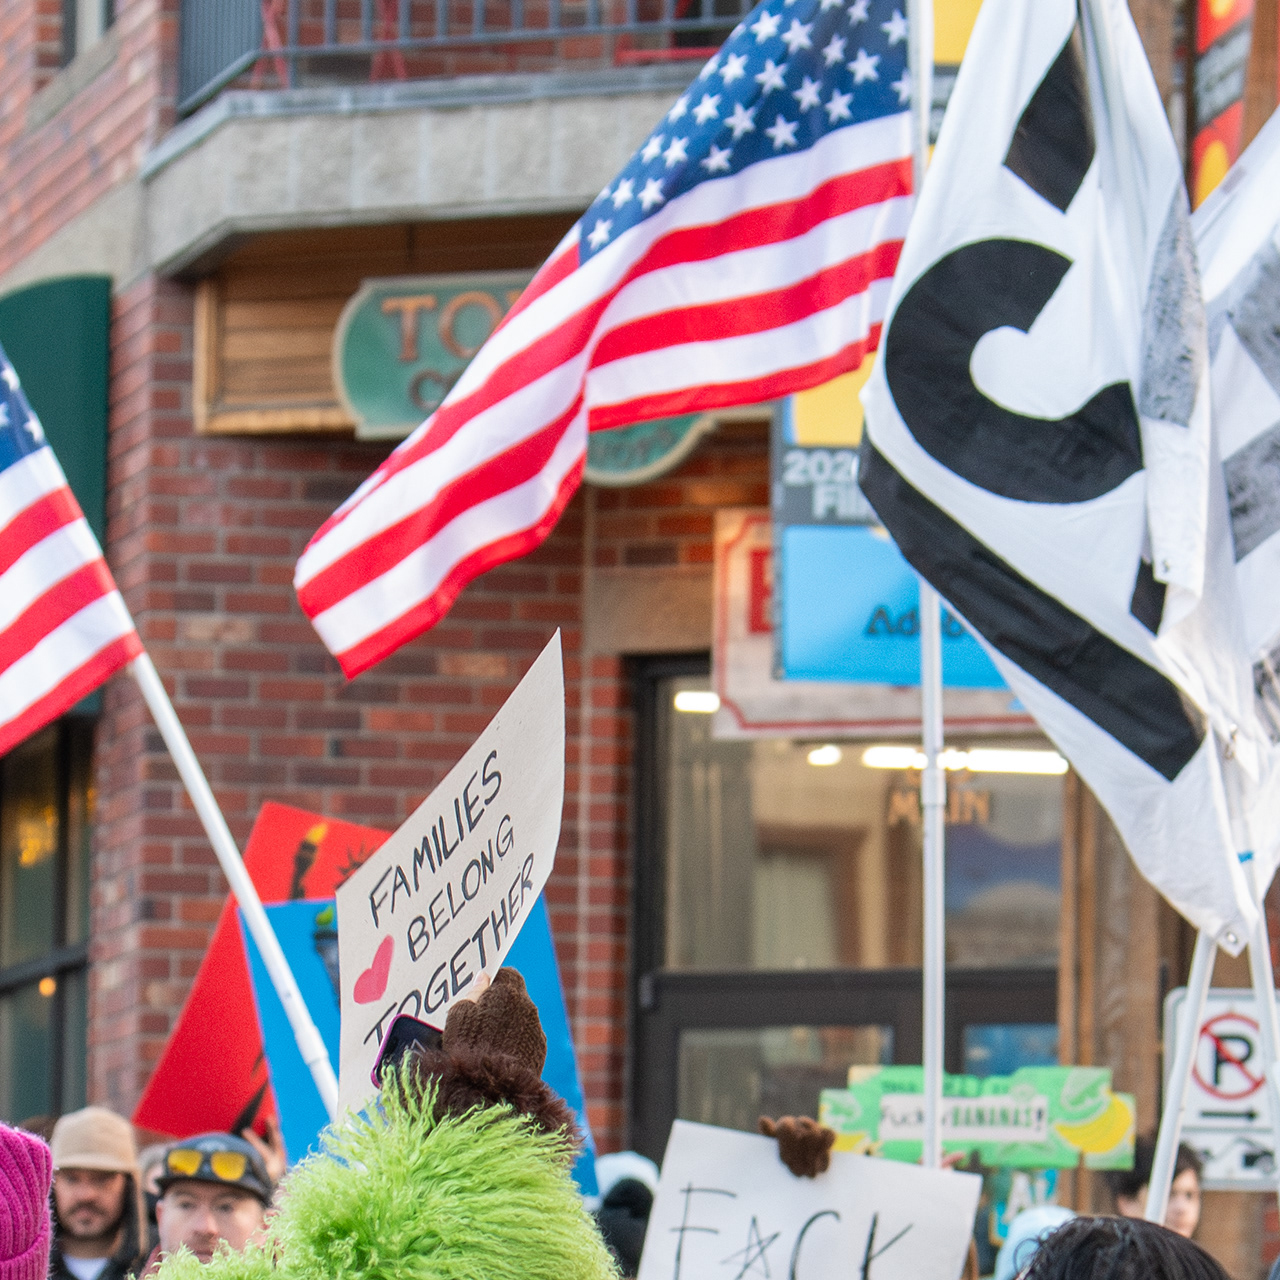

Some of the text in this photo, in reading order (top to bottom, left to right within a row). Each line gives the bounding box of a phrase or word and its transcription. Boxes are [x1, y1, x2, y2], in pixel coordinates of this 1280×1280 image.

[380, 290, 520, 363] TO
[782, 450, 860, 486] 202
[369, 750, 502, 929] FAMILIES
[887, 790, 991, 825] MIN
[406, 813, 515, 963] BELONG
[363, 851, 535, 1047] TOGETHER
